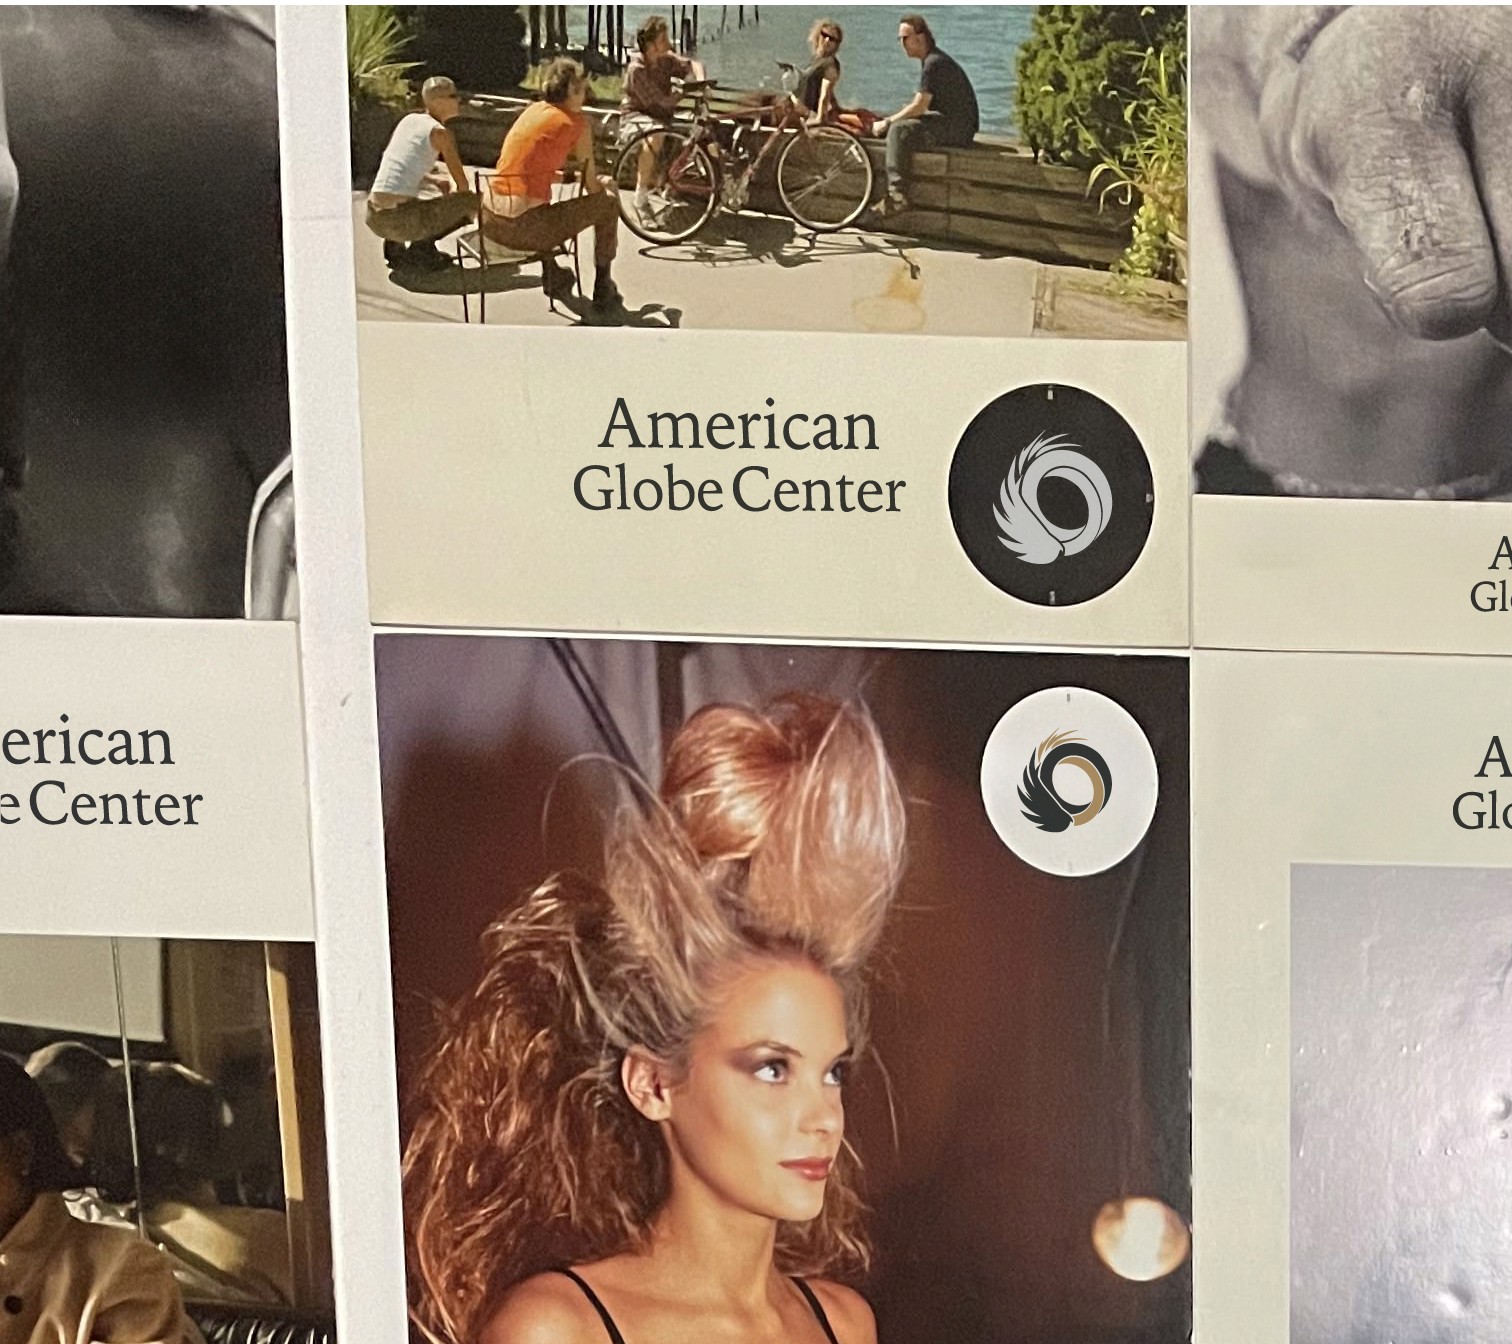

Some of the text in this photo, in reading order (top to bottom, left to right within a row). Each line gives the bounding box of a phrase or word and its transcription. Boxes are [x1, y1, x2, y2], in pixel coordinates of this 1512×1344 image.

[597, 397, 880, 451] American
[573, 462, 907, 513] Globe Center
[2, 713, 176, 766] erican
[29, 779, 204, 826] Center
